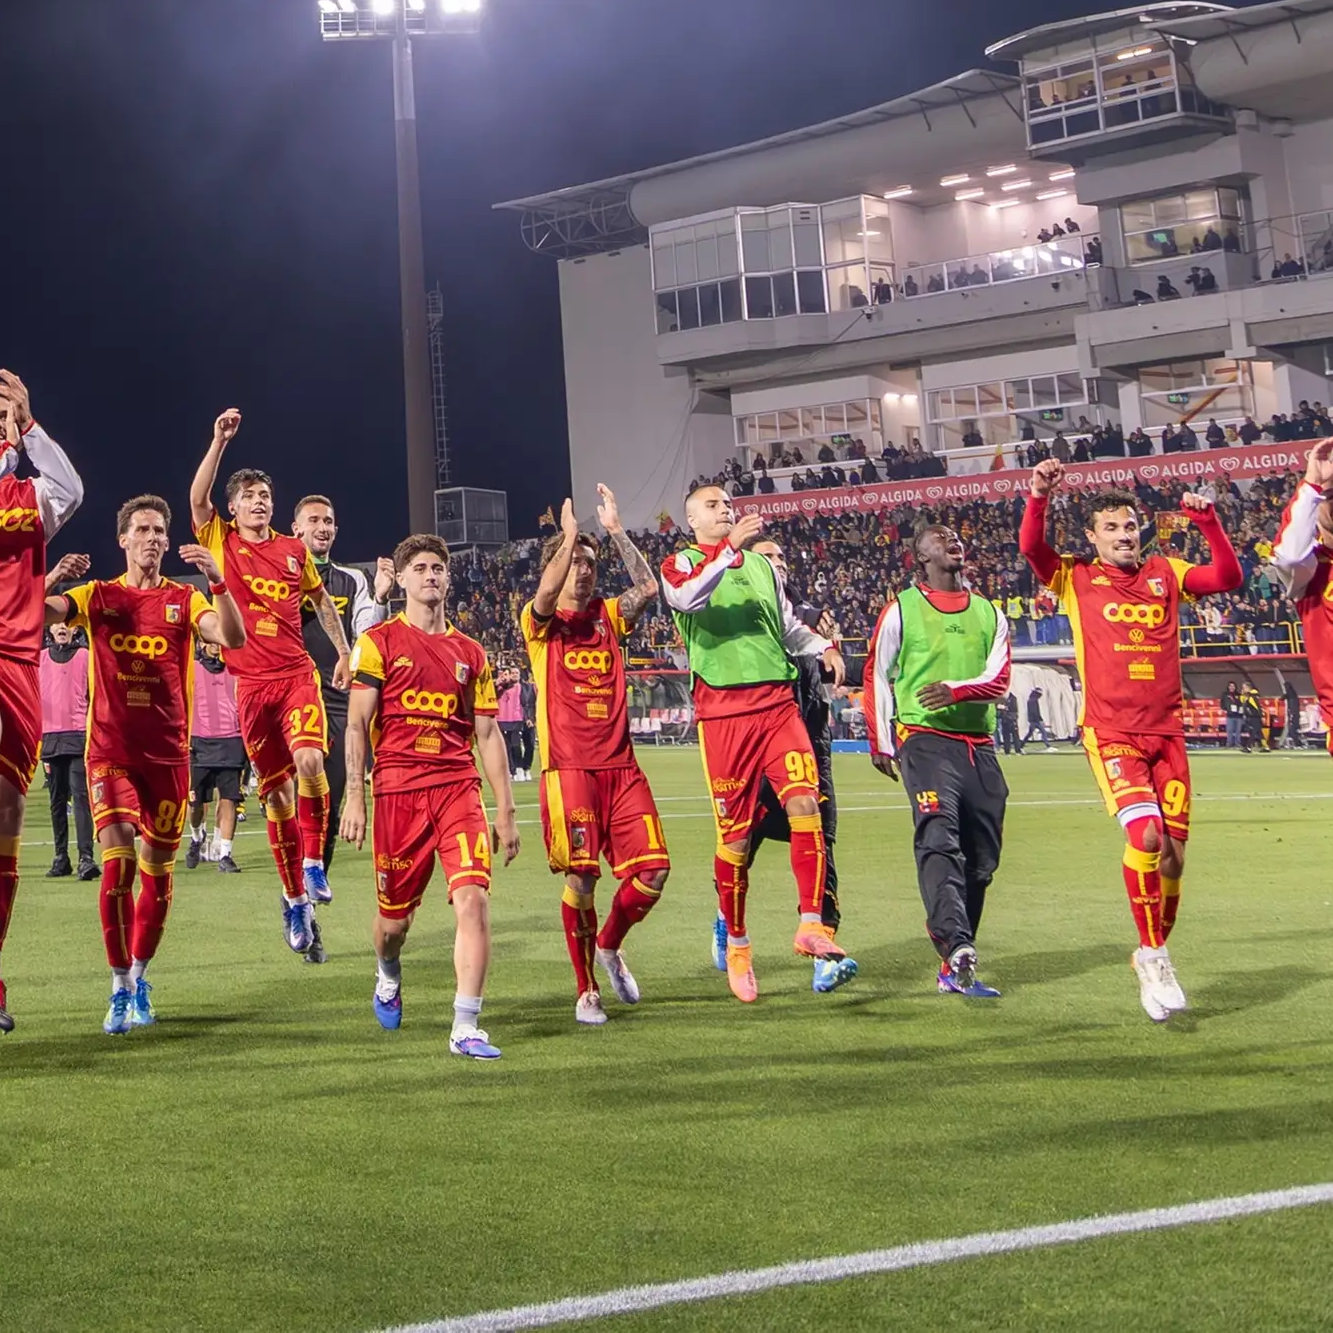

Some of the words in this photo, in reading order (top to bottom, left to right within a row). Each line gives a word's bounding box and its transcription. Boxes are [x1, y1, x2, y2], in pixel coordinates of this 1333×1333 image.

[760, 501, 799, 515] ALGIDA
[818, 496, 859, 510] ALGIDA
[880, 489, 922, 504] ALGIDA
[945, 483, 990, 498] ALGIDA
[1085, 469, 1134, 485] ALGIDA
[1162, 461, 1215, 478] ALGIDA
[1243, 453, 1299, 470] ALGIDA
[1103, 602, 1164, 629] coop
[109, 633, 168, 660] coop
[564, 651, 612, 674] coop
[400, 689, 458, 718] coop
[288, 704, 322, 737] 32
[784, 750, 819, 786] 98
[916, 791, 939, 803] US
[154, 799, 188, 834] 84
[455, 831, 490, 869] 14
